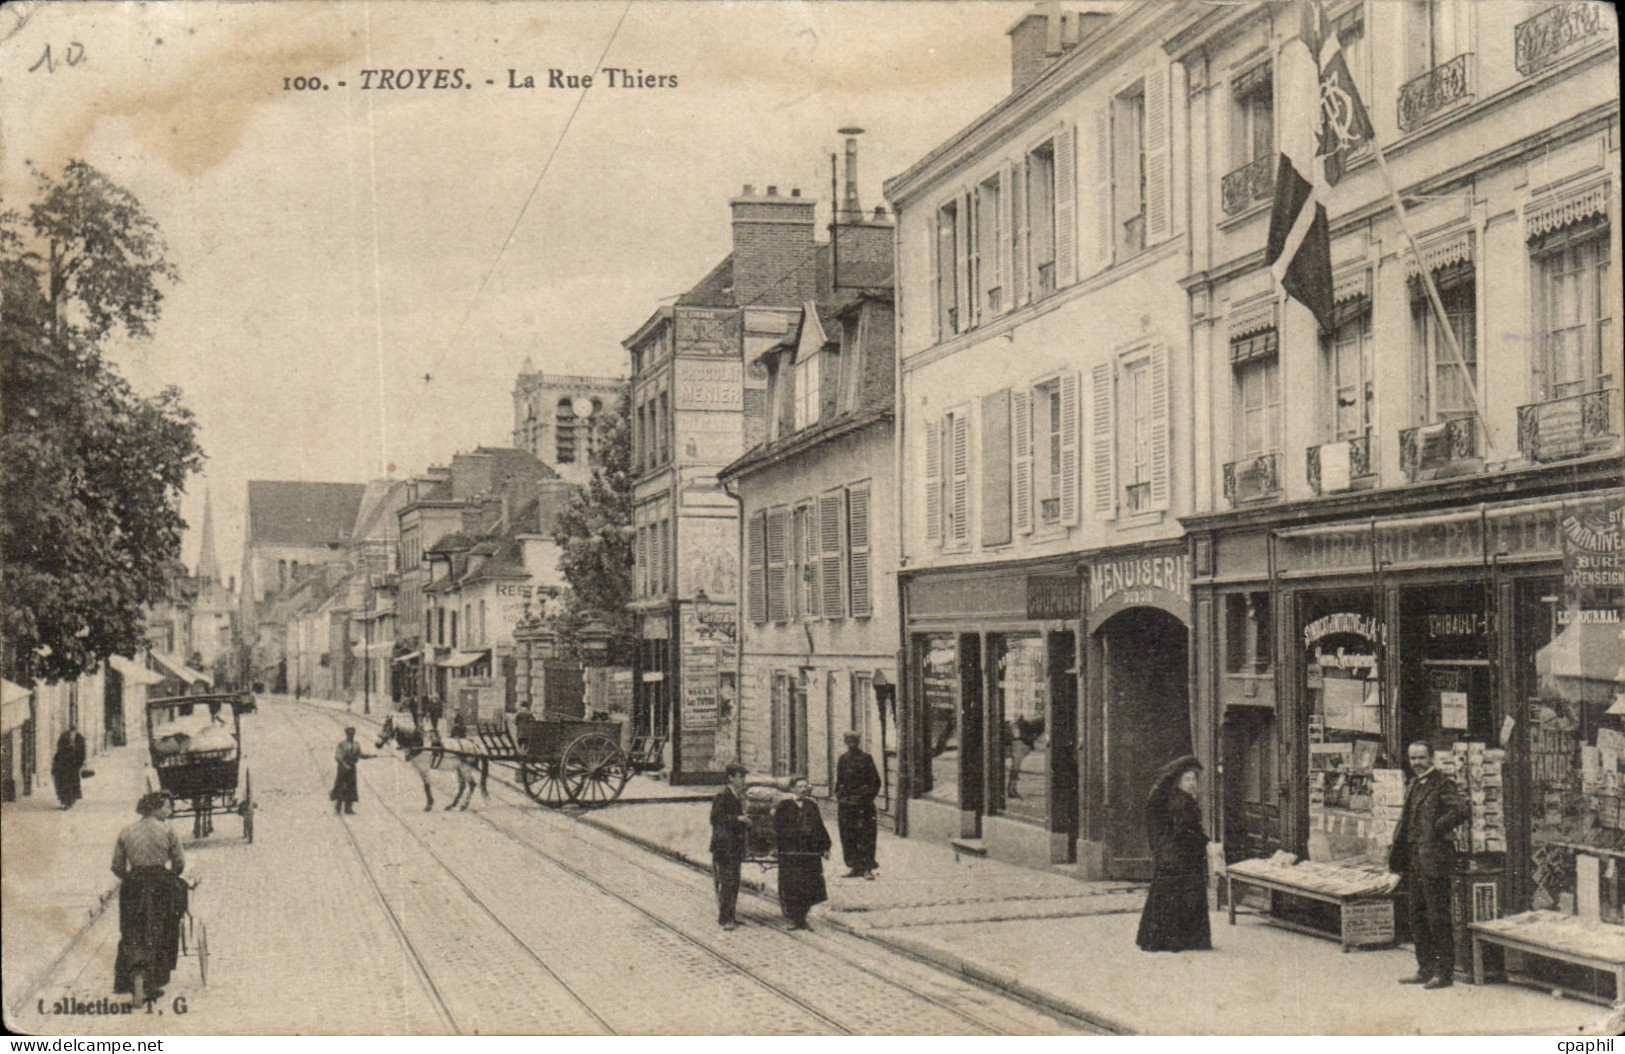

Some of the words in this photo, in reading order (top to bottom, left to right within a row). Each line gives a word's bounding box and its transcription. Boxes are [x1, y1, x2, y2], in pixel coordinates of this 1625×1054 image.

[680, 384, 740, 404] MENIER
[1090, 554, 1190, 612] MENUISERIE
[1557, 610, 1570, 625] LE
[1575, 608, 1621, 625] JOURNAL
